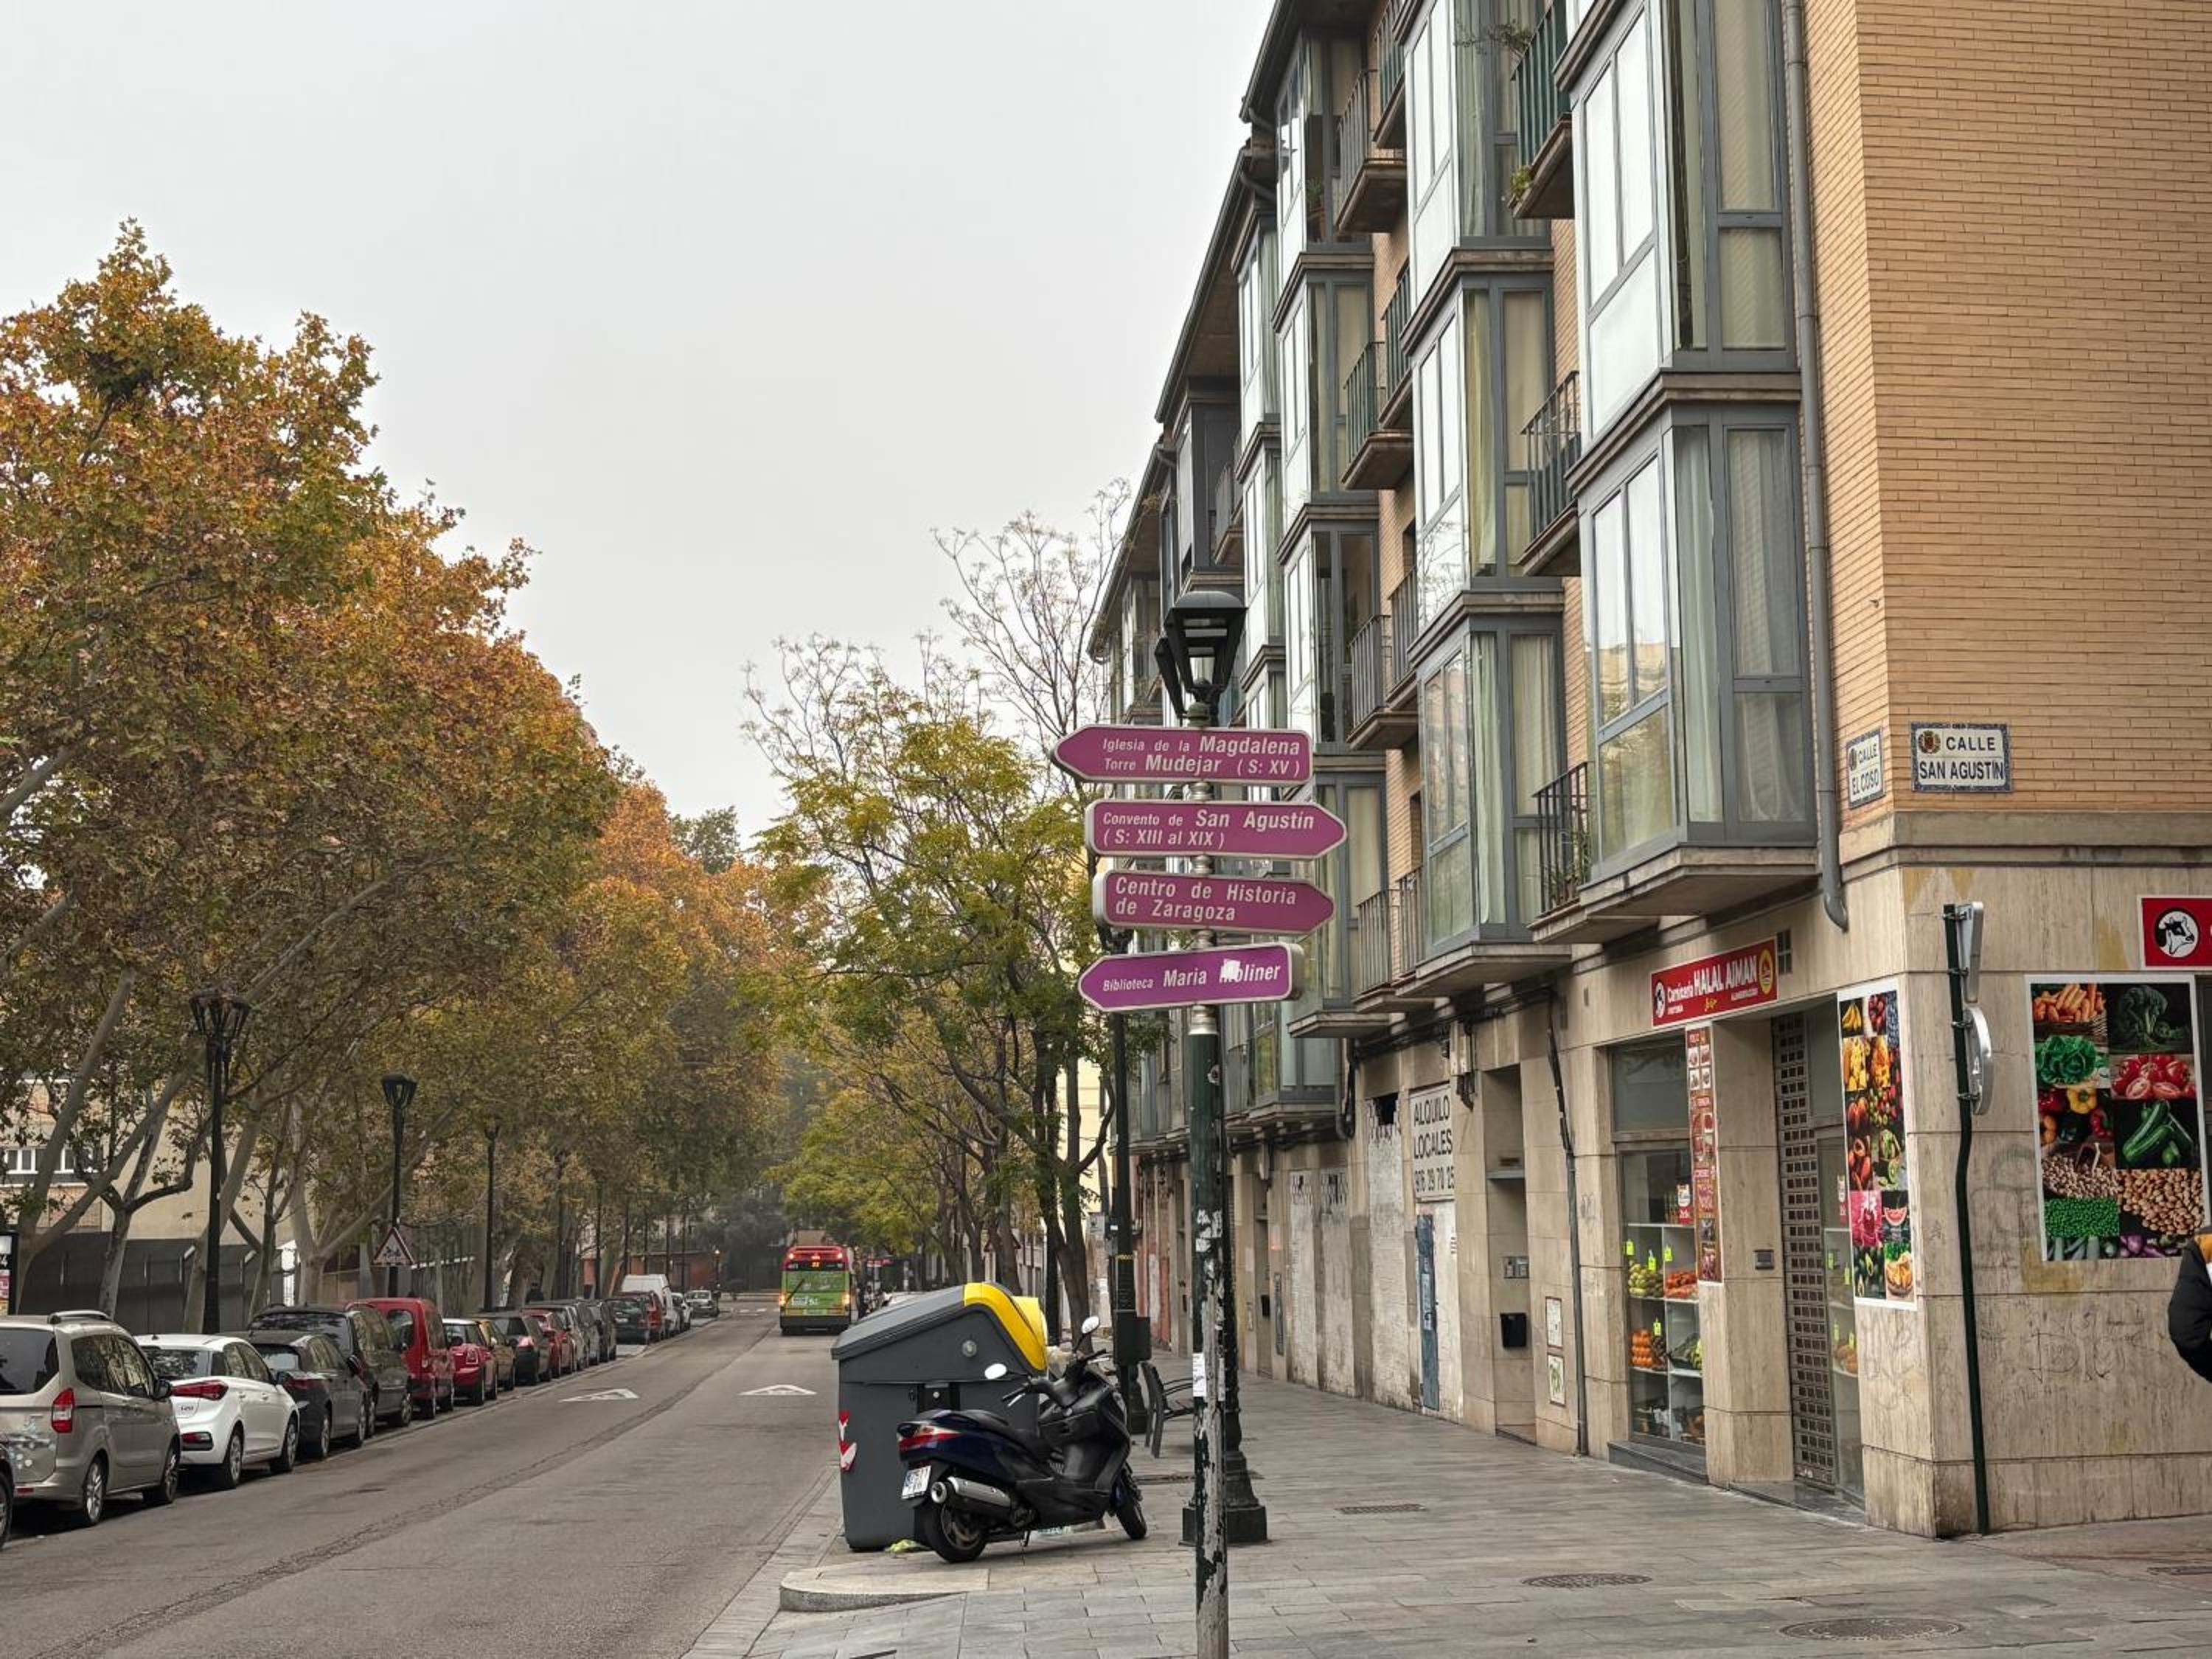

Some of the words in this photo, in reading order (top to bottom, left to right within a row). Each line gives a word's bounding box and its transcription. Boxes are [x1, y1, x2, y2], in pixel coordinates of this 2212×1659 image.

[1103, 737, 1145, 752] Iglesia
[1155, 740, 1169, 751] de
[1179, 740, 1190, 752] la
[1200, 735, 1300, 757] Magdalena
[1858, 743, 1878, 764] CALLE
[1946, 737, 1996, 751] CALLE
[1105, 757, 1135, 771] Torre
[1145, 754, 1222, 776] Mudejar
[1919, 761, 1946, 779] SAN
[1852, 776, 1860, 796] EL
[1861, 768, 1879, 793] COSO
[1103, 812, 1161, 826] Convento
[1169, 814, 1183, 826] de
[1195, 810, 1231, 827] San
[1136, 830, 1163, 844] XIII
[1168, 831, 1183, 845] al
[1116, 876, 1177, 897] Centro
[1191, 882, 1212, 899] de
[1226, 884, 1297, 905] Historia
[1116, 897, 1137, 915] de
[1152, 899, 1235, 923] Zaragoza
[1103, 978, 1154, 992] Biblioteca
[1219, 964, 1281, 983] oliner
[1694, 964, 1725, 997] HALAL
[1413, 1095, 1450, 1127] ALQUILO
[1413, 1129, 1453, 1159] LOCALES
